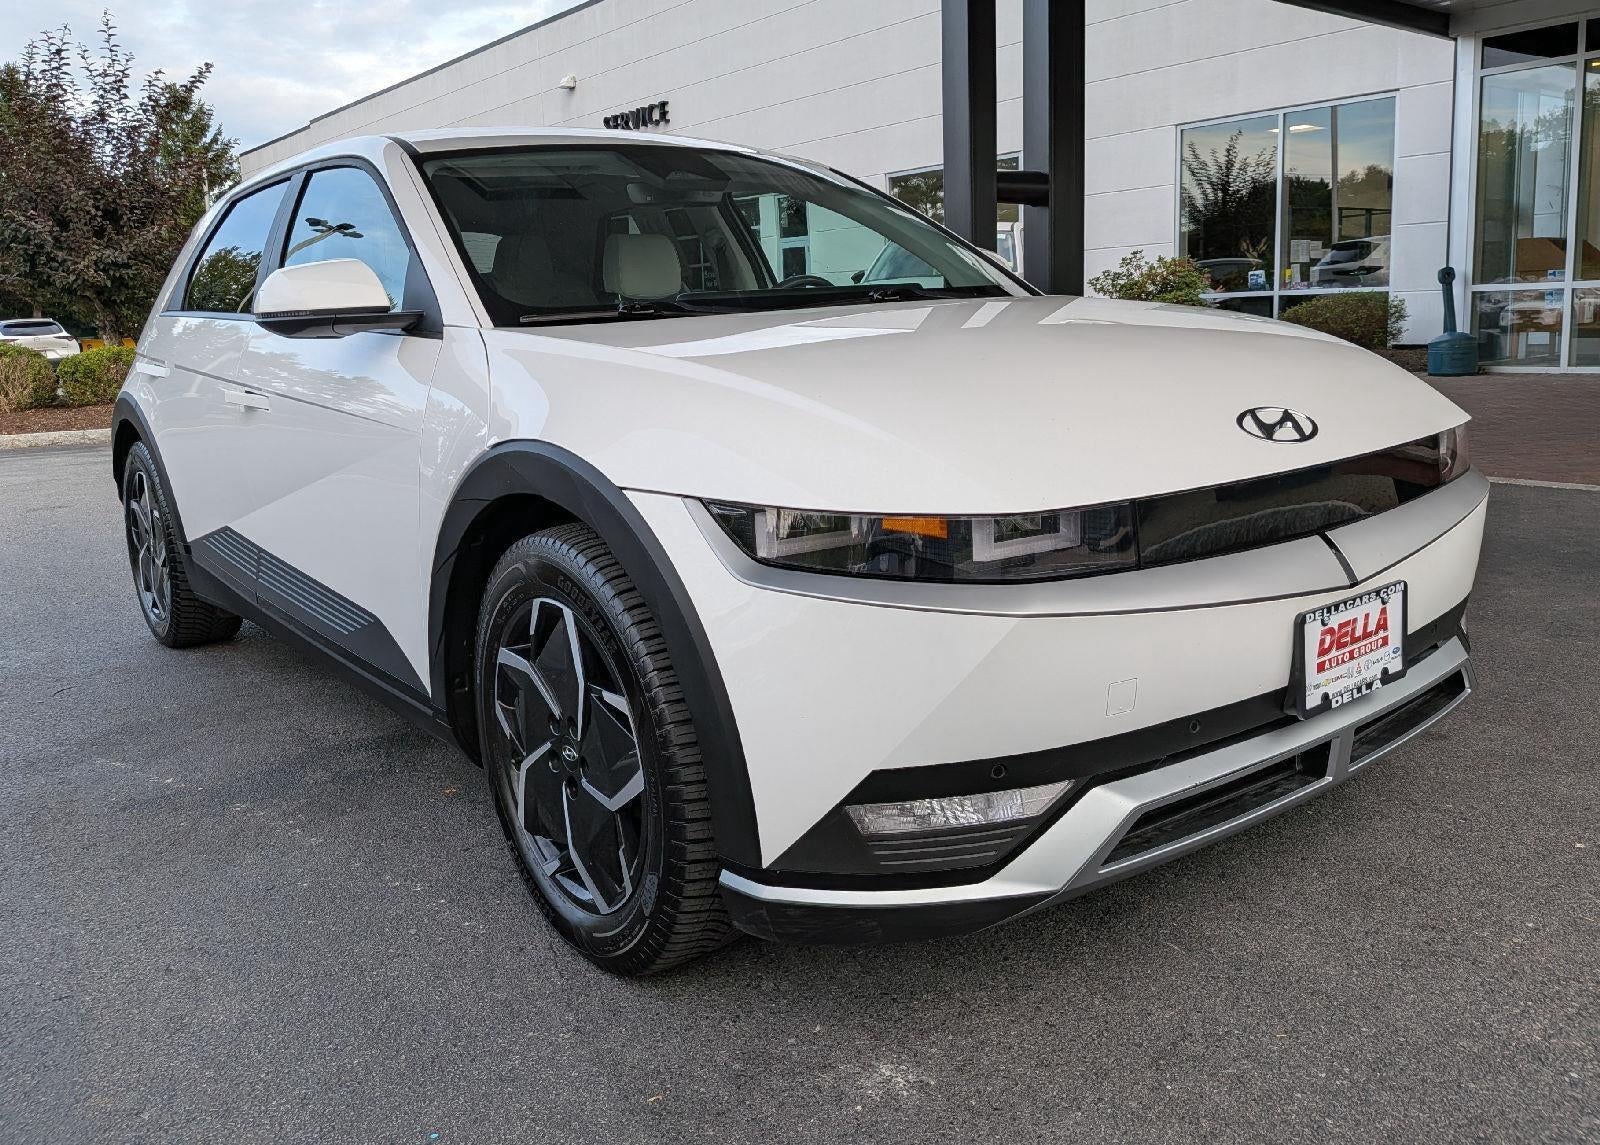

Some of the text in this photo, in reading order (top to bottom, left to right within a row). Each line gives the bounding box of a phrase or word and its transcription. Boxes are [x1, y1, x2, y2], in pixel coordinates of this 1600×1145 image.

[603, 101, 670, 130] SERVICE
[1305, 581, 1405, 623] DELLACARS.COM
[1316, 605, 1389, 659] DELLA
[1324, 653, 1350, 670] AUTO
[1354, 638, 1383, 657] GROUP
[1331, 680, 1383, 709] DELLA
